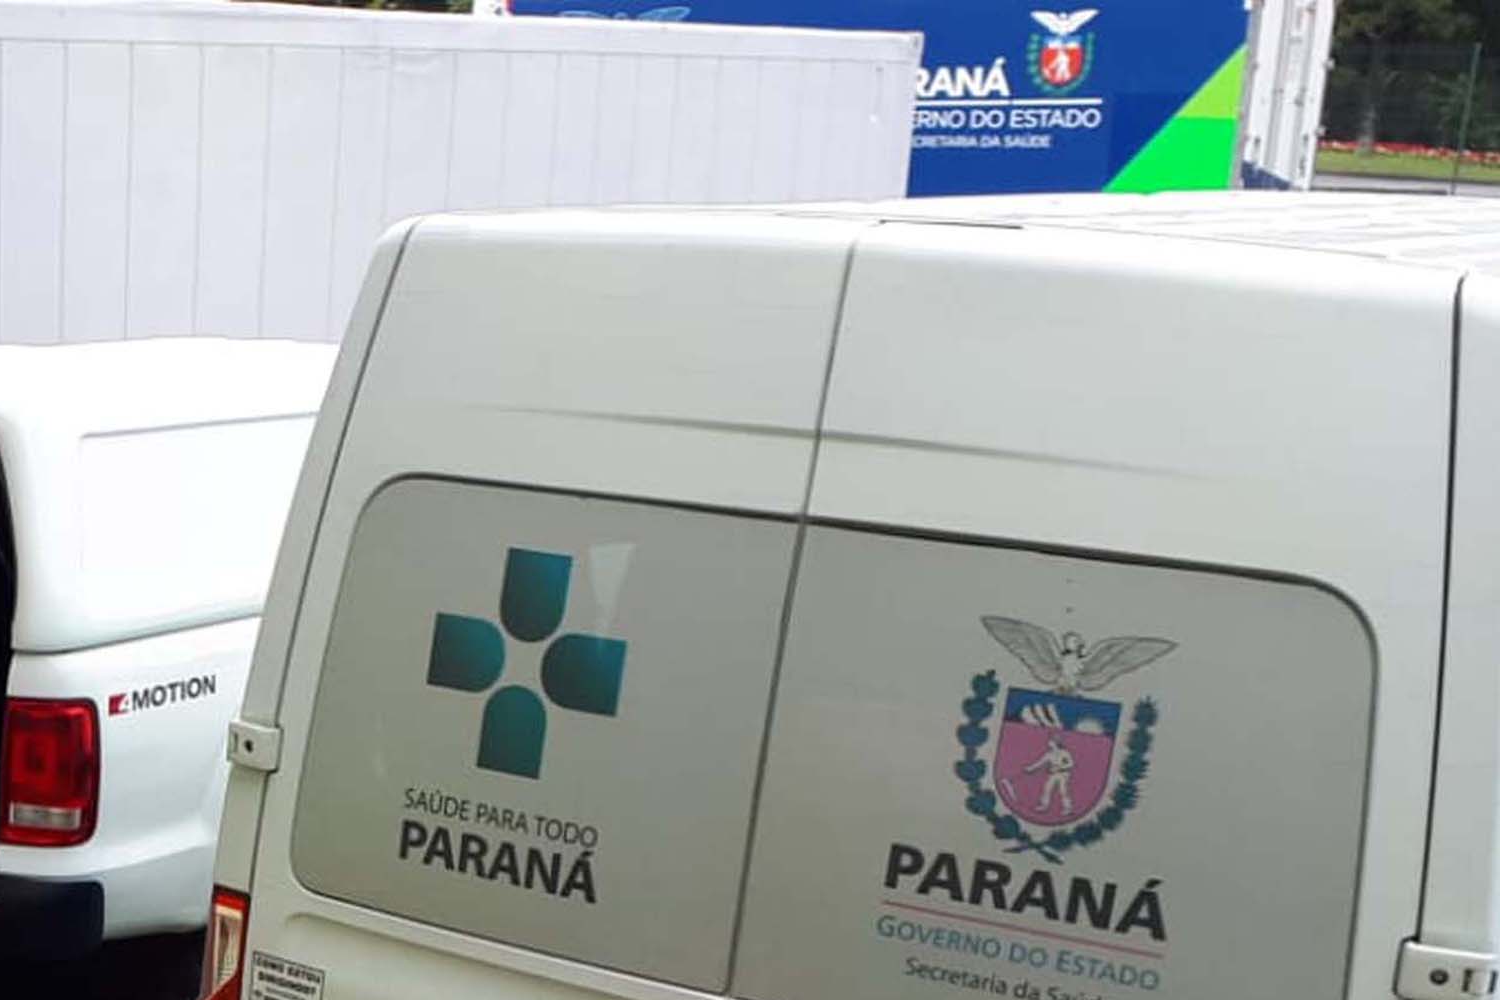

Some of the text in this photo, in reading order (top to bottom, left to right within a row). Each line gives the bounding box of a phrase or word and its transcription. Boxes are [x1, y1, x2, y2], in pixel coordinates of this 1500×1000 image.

[916, 56, 1010, 97] RANÁ
[912, 135, 978, 149] CRETARIA
[980, 136, 1000, 149] DA
[913, 108, 1101, 129] ERNO DO ESTADO
[403, 787, 598, 848] SAÚDE PARA TODO
[398, 820, 598, 904] PARANÁ
[883, 843, 1168, 942] PARANÁ
[876, 915, 1161, 992] GOVERNO DO ESTADO
[904, 956, 1007, 997] Secretaria
